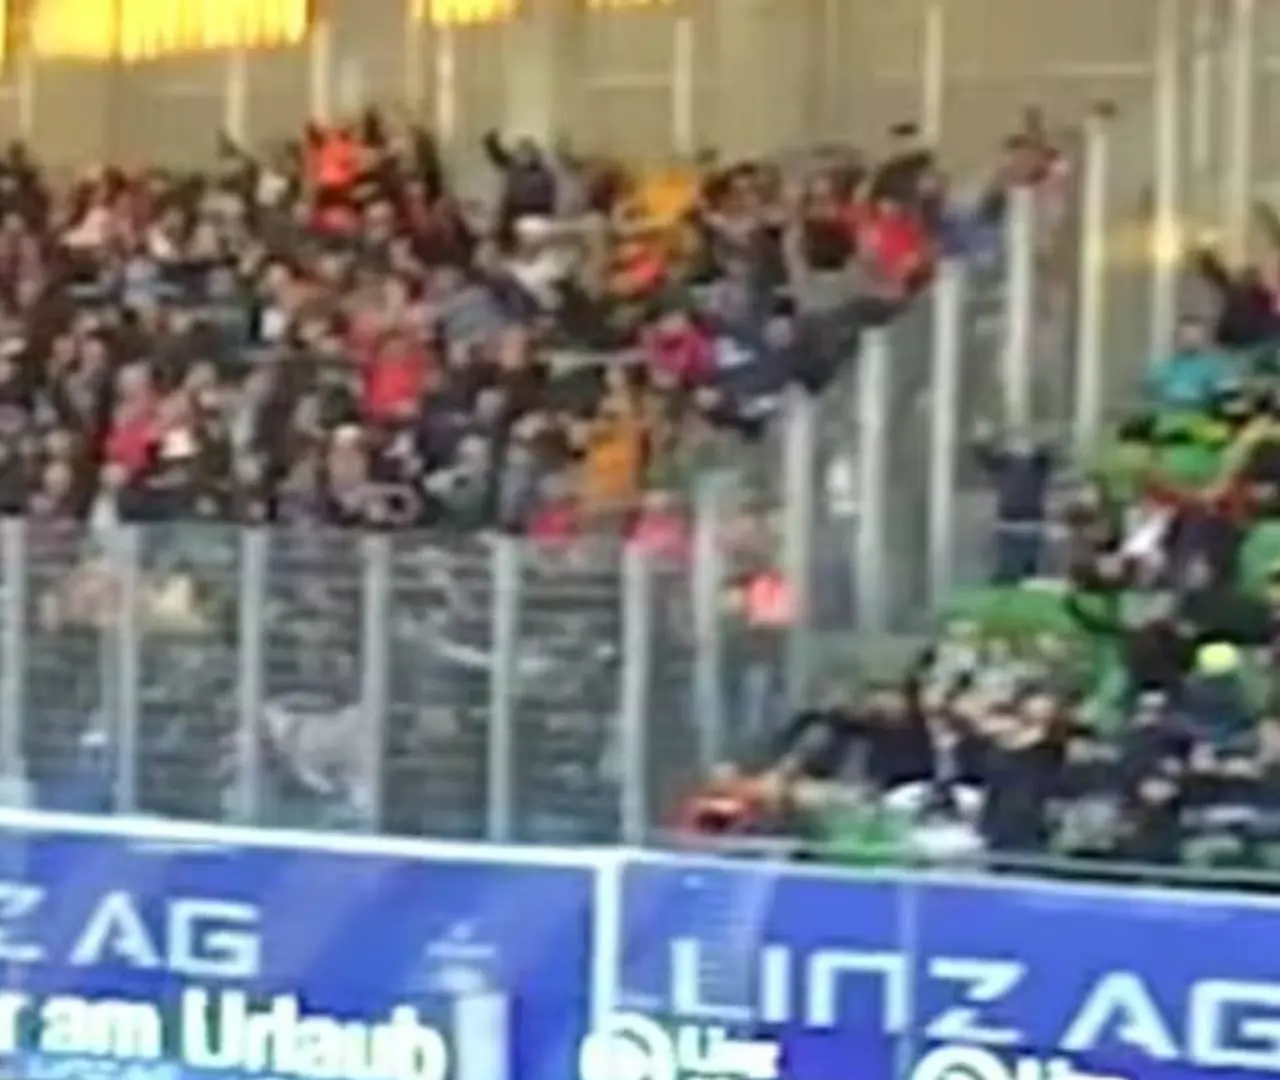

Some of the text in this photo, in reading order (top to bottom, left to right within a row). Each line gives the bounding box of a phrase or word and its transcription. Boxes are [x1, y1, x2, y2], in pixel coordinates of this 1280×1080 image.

[68, 892, 261, 974] AG
[40, 992, 164, 1058] am
[670, 935, 1280, 1068] LINZ AG
